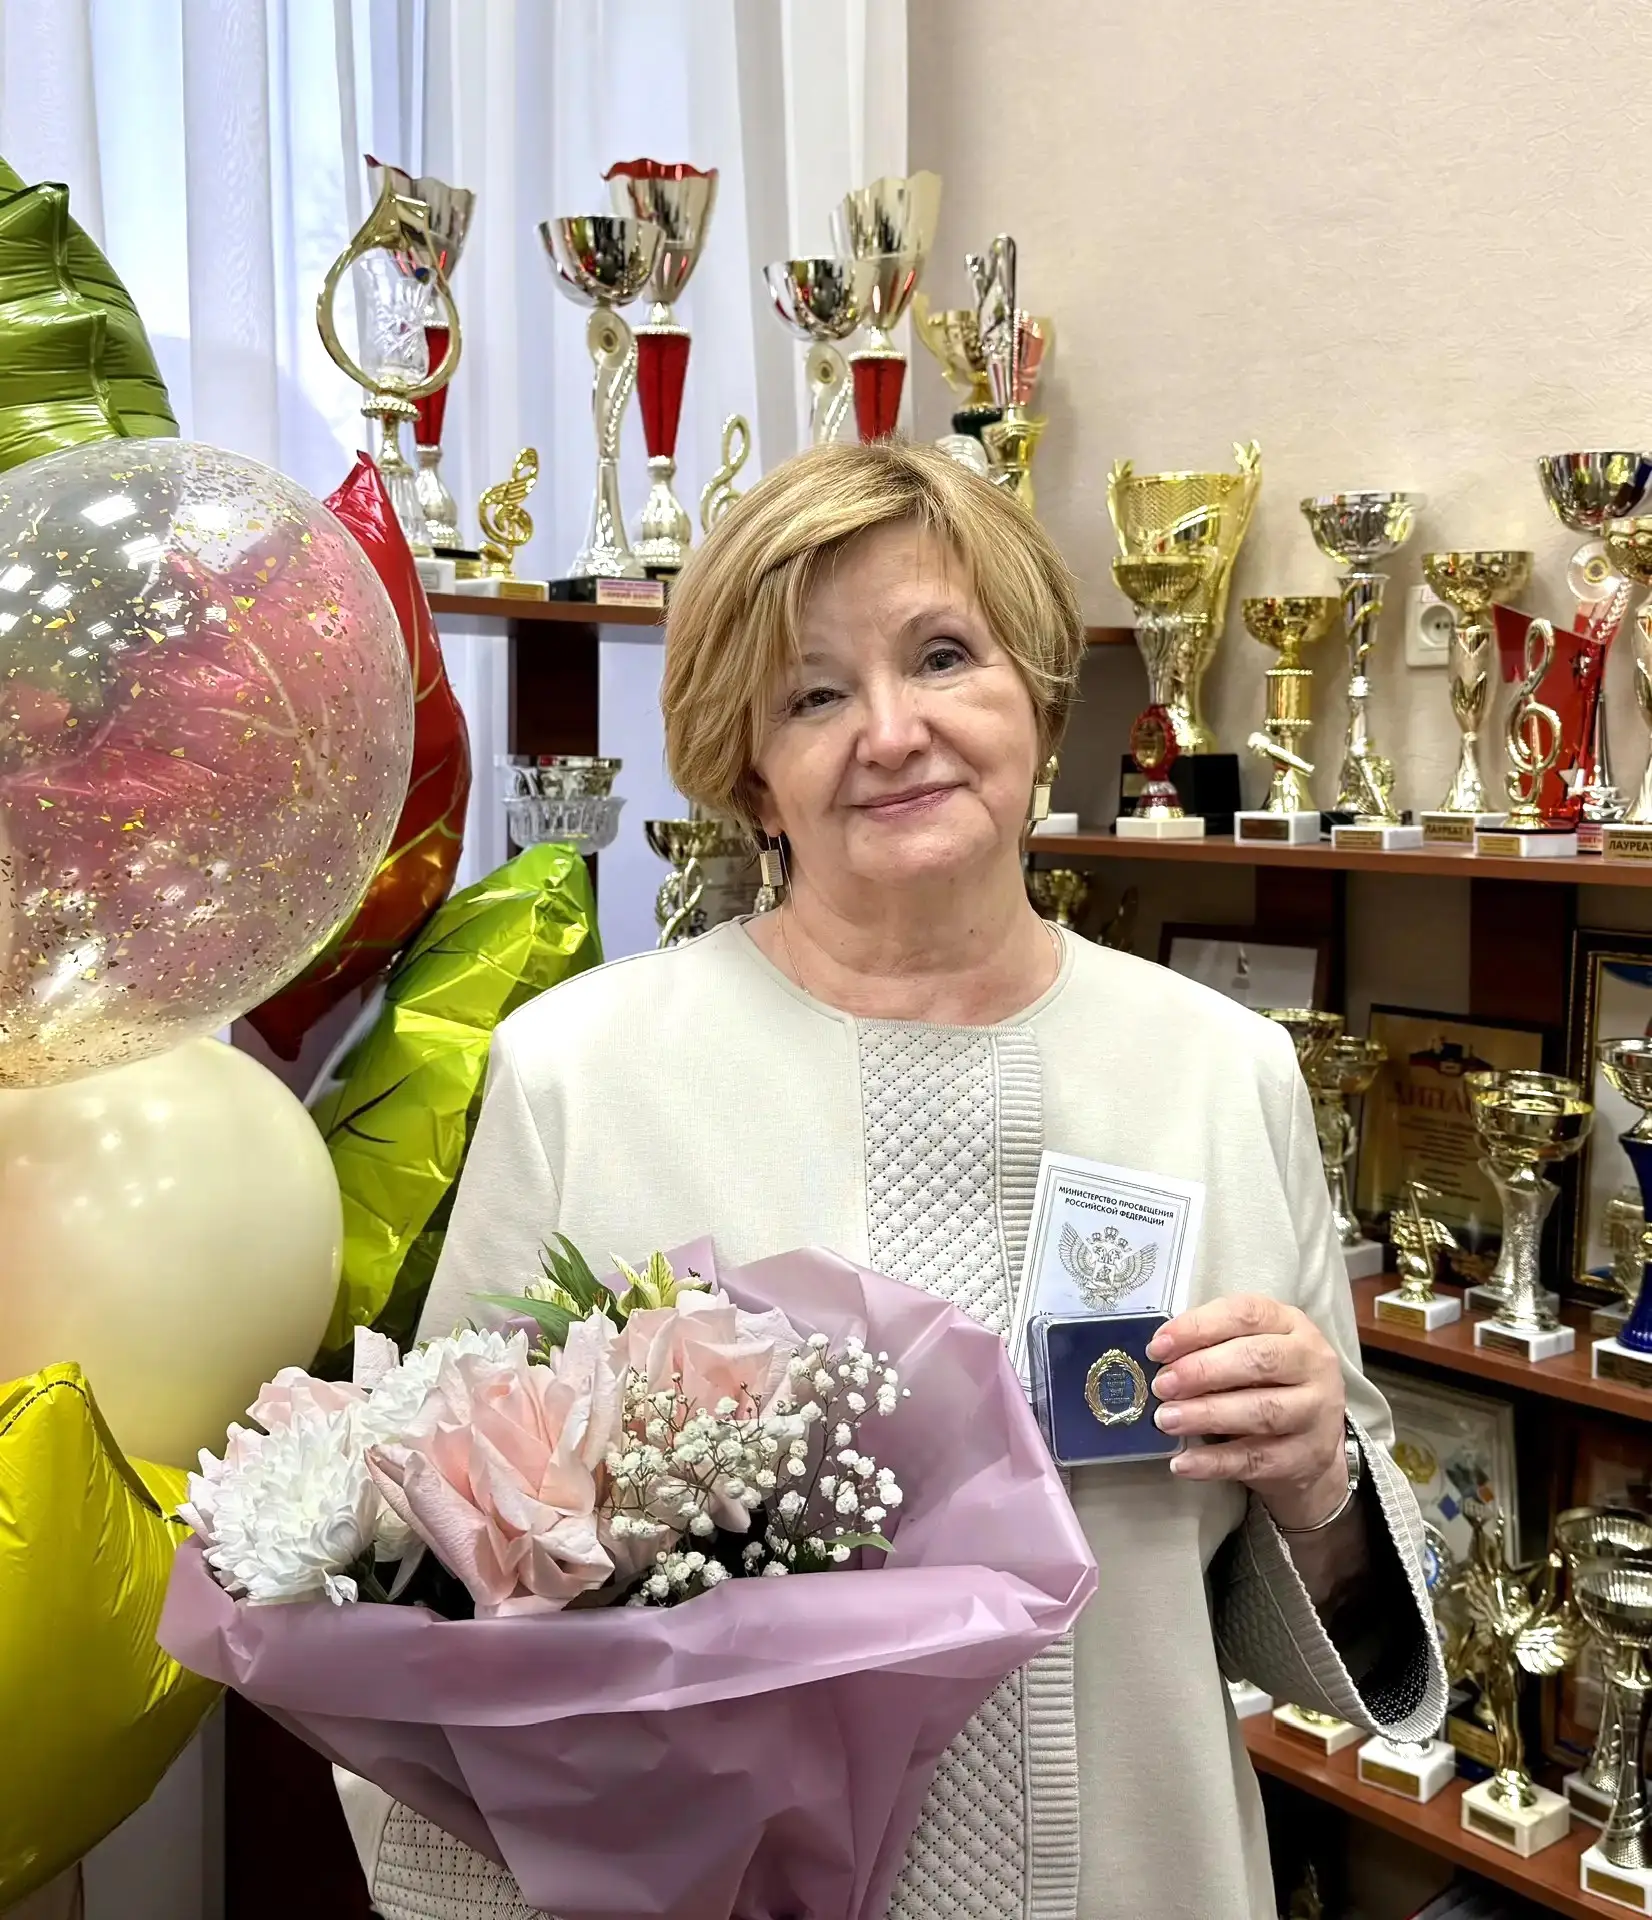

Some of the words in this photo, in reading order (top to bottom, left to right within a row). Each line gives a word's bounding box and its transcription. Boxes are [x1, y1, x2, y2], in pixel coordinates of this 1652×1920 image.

[1059, 1186, 1118, 1206] МИНИСТЕРСТВО
[1119, 1200, 1174, 1219] ПРОСВЕЩЕНИЯ
[1065, 1198, 1118, 1216] РОССИЙСКОЙ
[1120, 1211, 1165, 1227] ФЕДЕРАЦИИ
